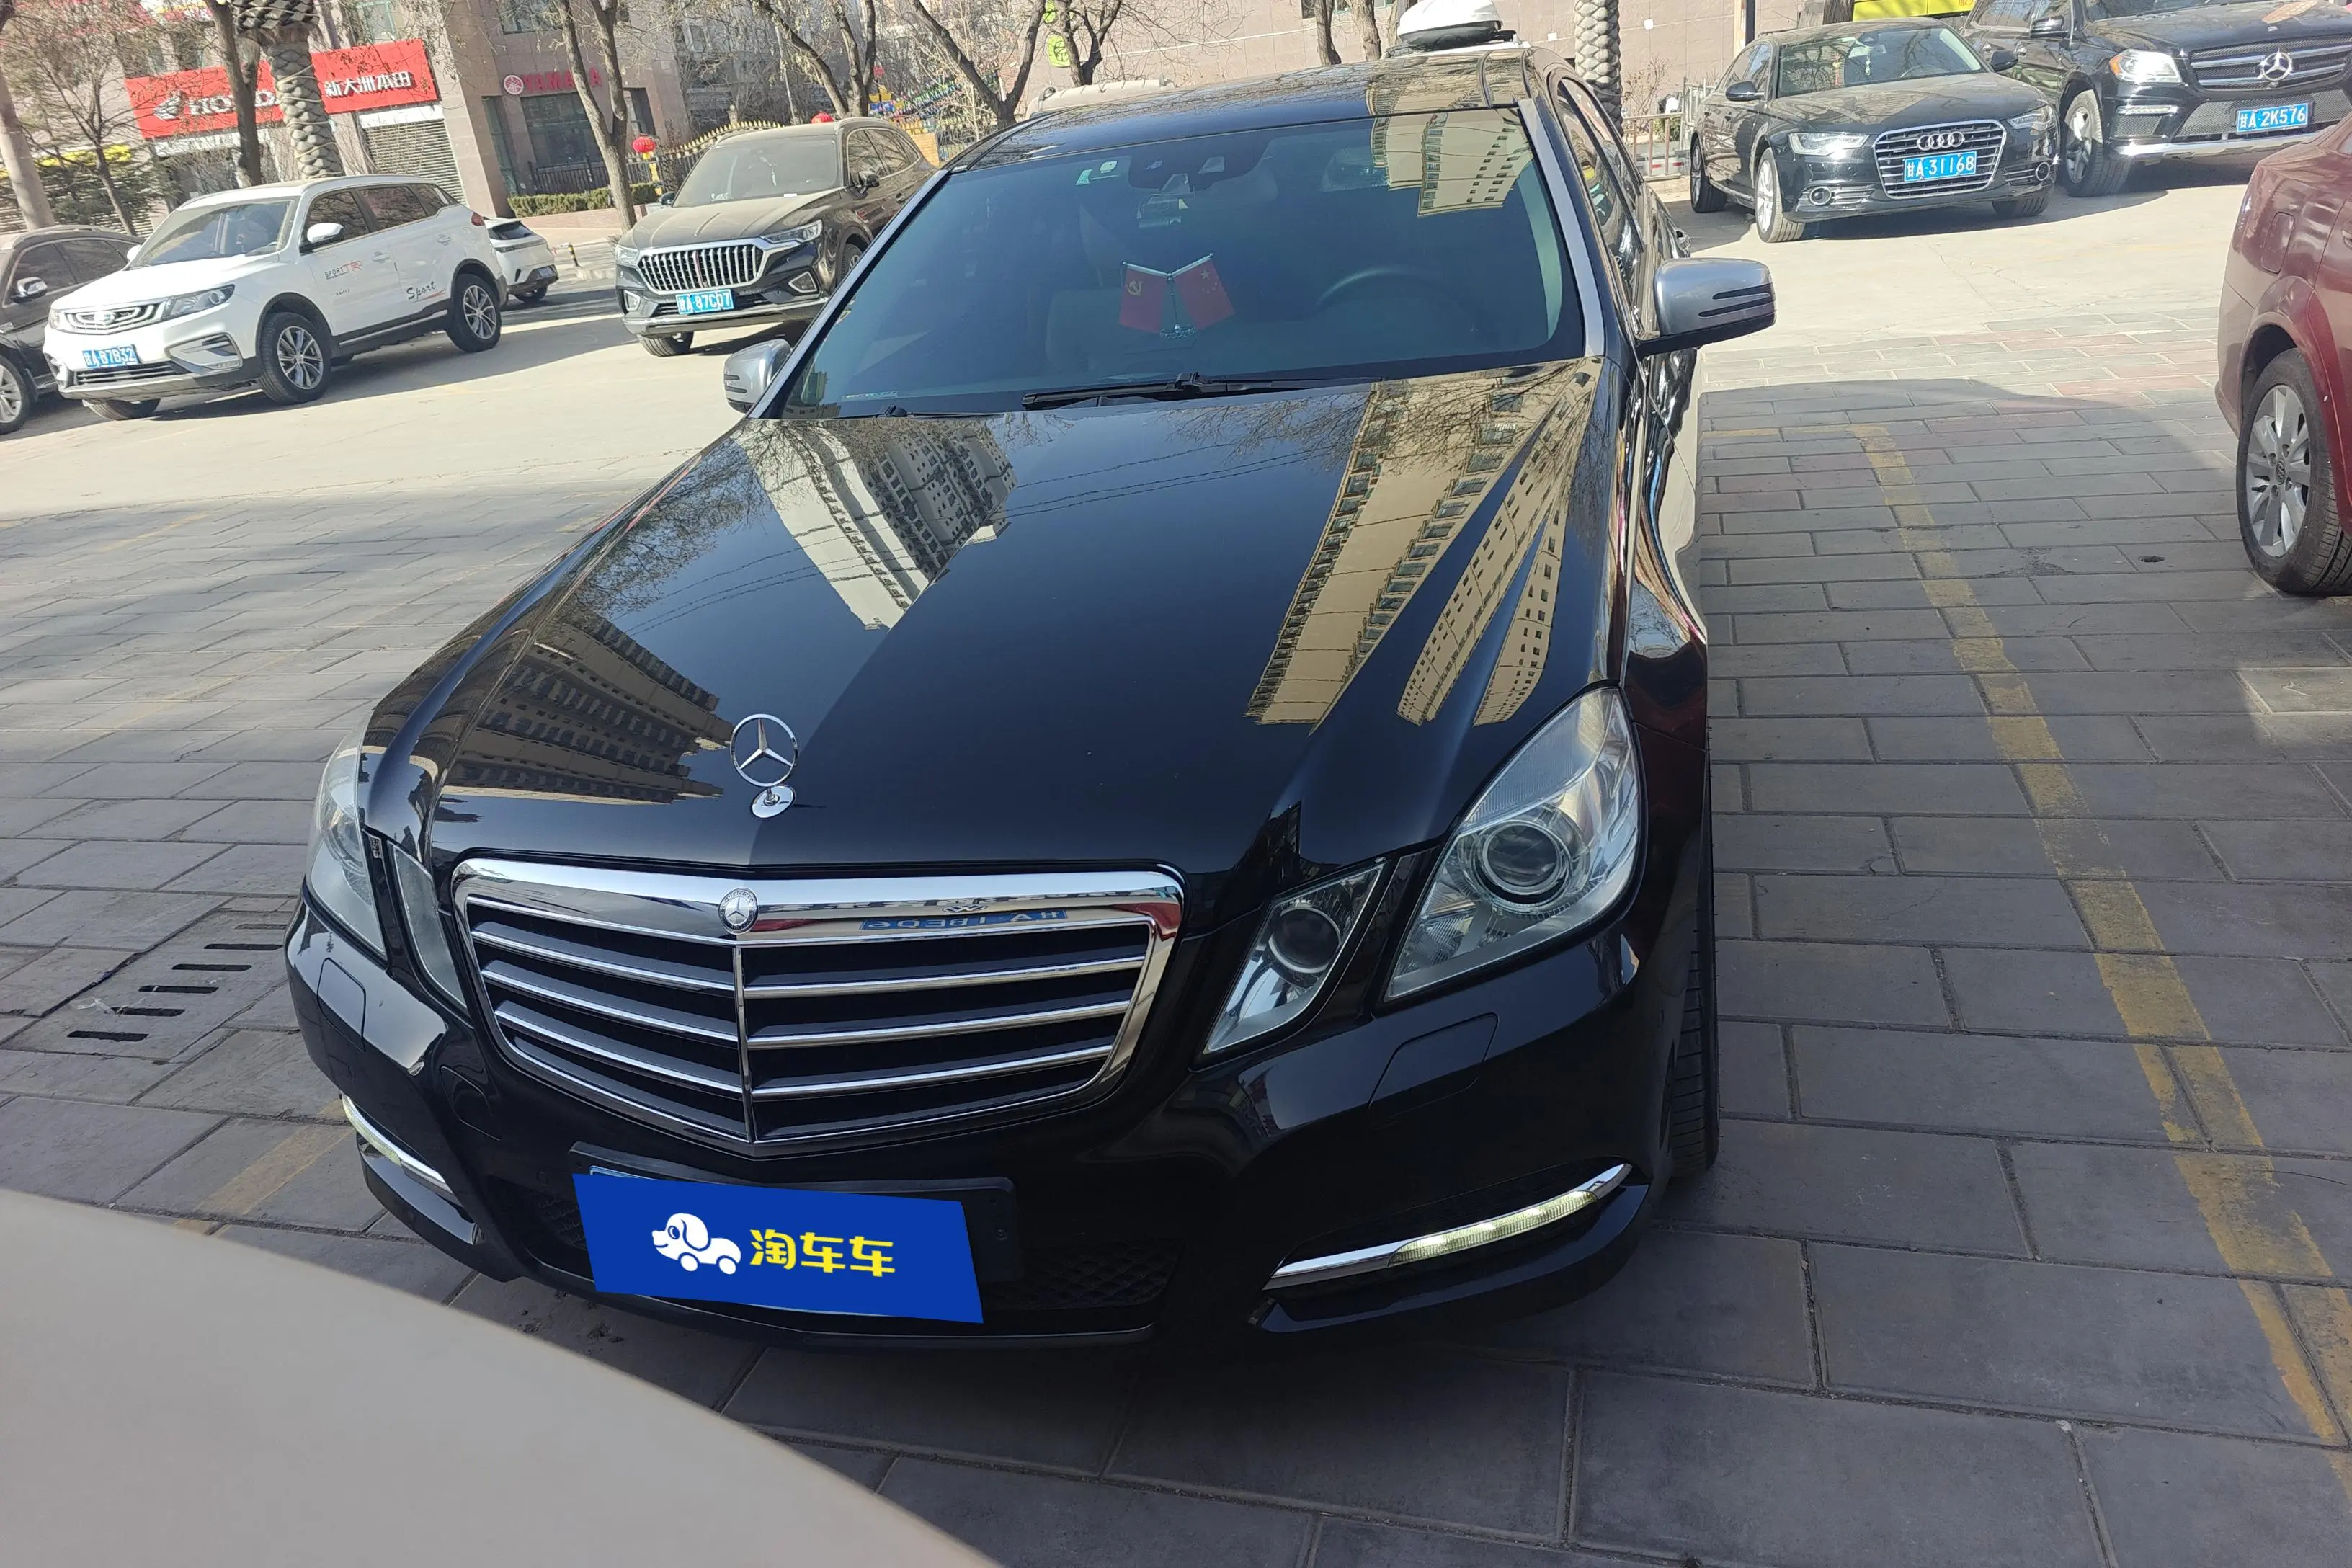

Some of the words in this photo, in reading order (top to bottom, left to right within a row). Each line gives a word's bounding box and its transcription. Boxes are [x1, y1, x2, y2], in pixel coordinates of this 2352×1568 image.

[324, 71, 411, 97] 新大洲本田
[522, 67, 603, 94] YAMAA
[406, 281, 437, 300] Sport
